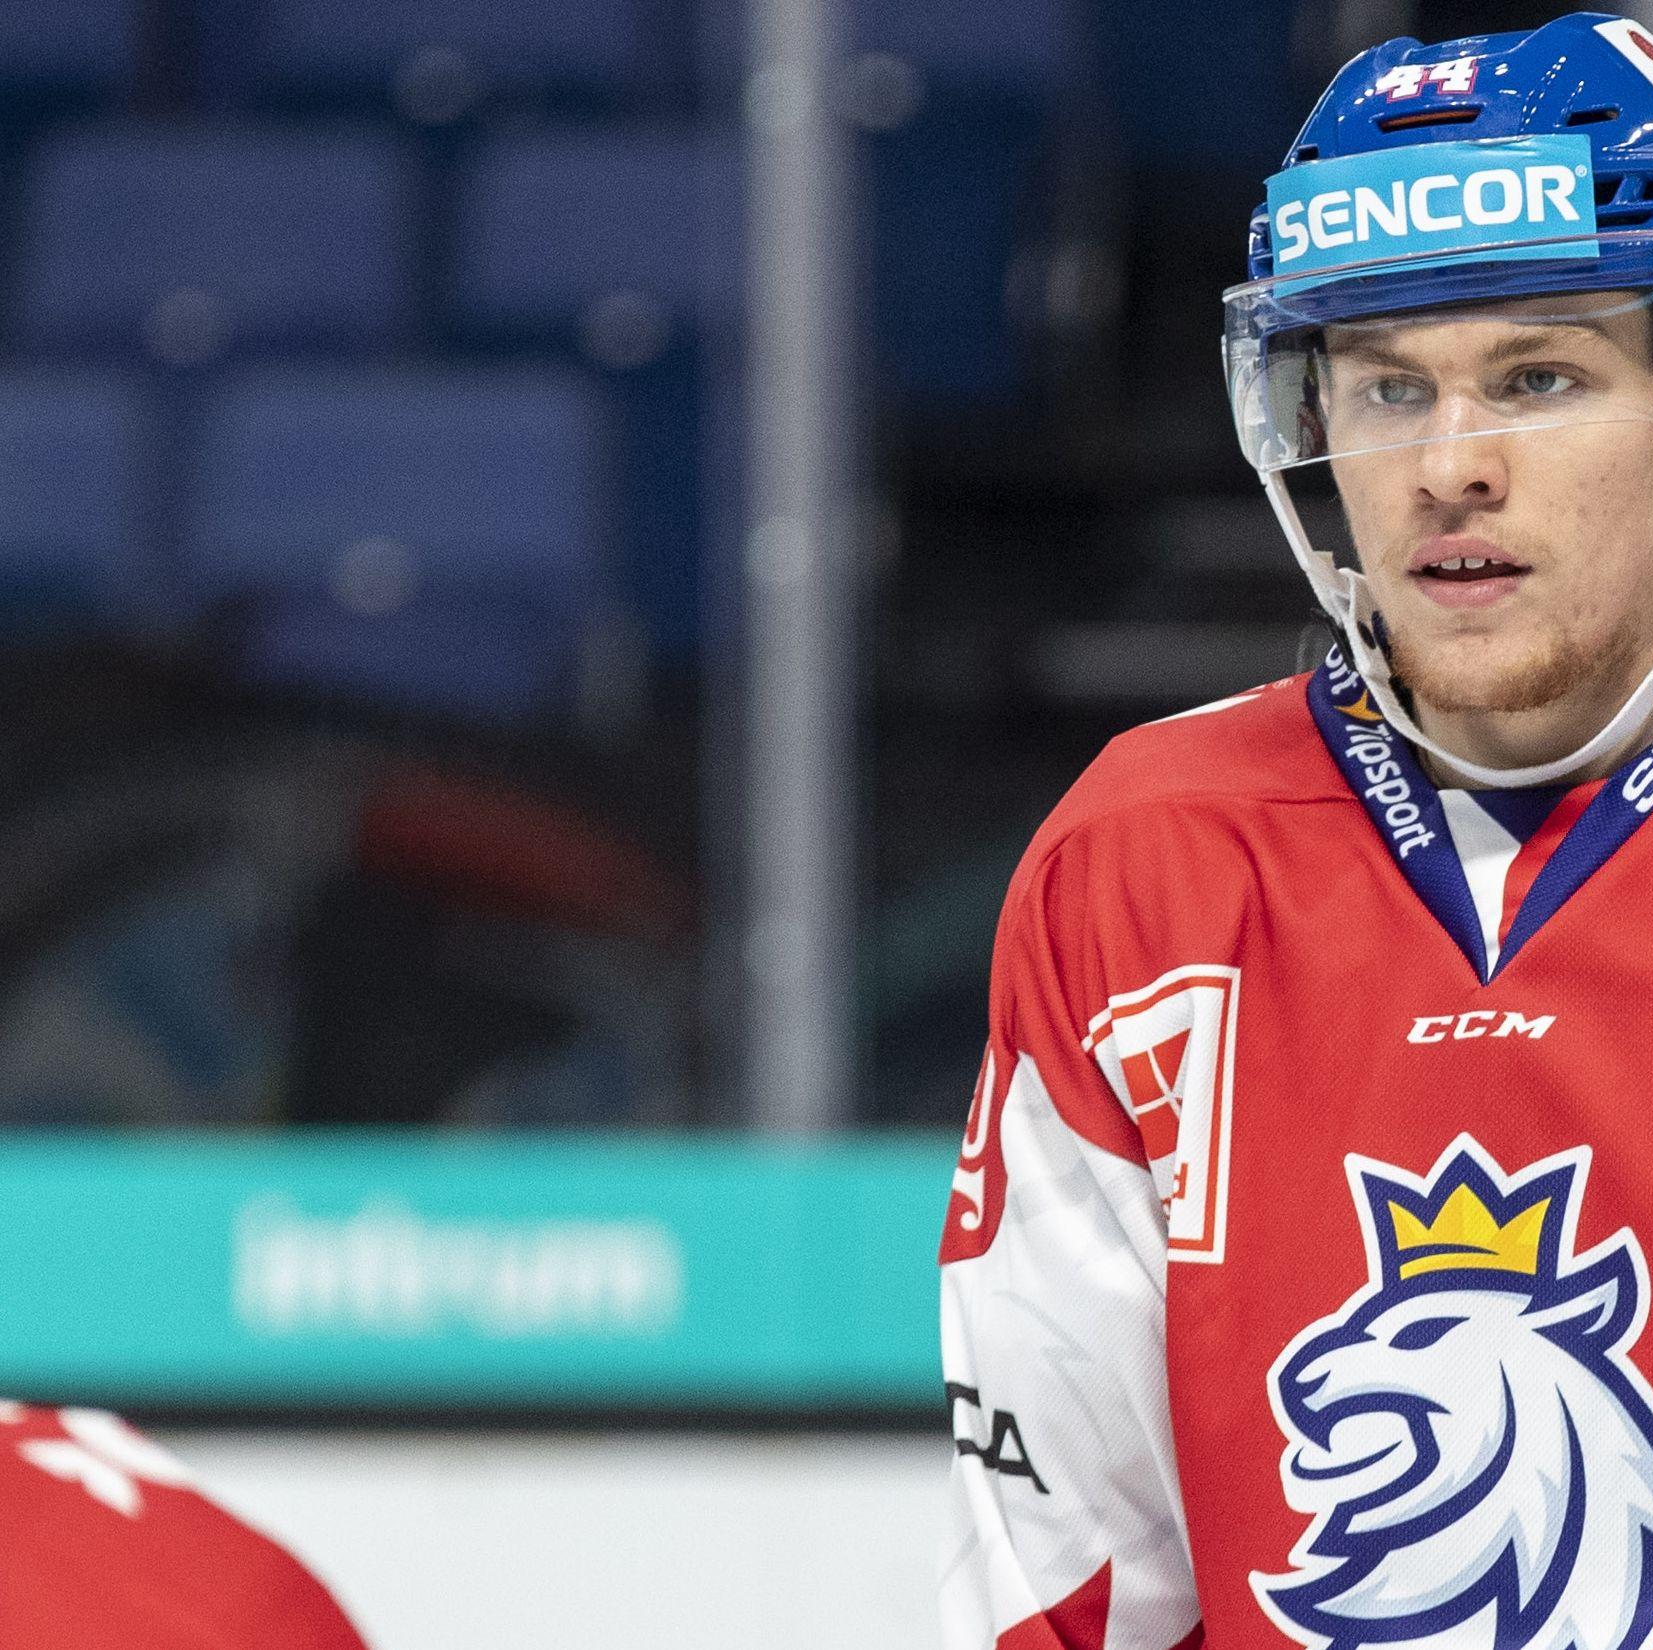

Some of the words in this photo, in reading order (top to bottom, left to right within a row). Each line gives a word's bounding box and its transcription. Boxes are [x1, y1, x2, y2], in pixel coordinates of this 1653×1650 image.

[1376, 57, 1479, 102] 44
[1275, 164, 1581, 264] SENCOR
[1345, 723, 1436, 859] Tipsport
[1406, 1009, 1558, 1044] CCM
